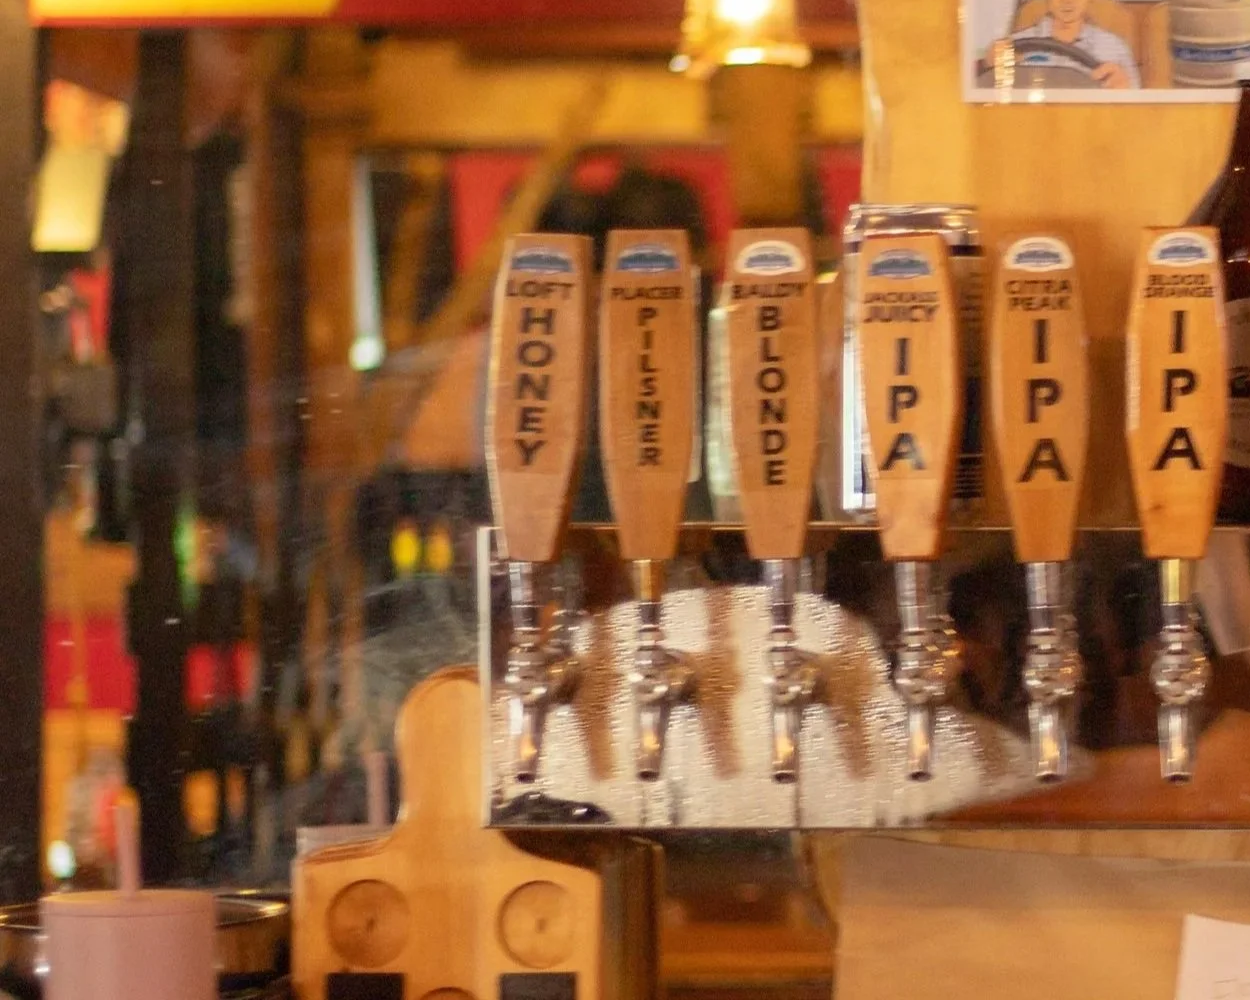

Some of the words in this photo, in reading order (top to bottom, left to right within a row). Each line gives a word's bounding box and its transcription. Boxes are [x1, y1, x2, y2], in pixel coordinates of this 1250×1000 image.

[506, 280, 575, 298] LOFT
[514, 307, 556, 467] HONEY
[635, 306, 663, 468] PILSNER
[757, 305, 787, 487] BLONDE
[879, 336, 928, 471] IPA
[1016, 318, 1073, 483] IPA
[1150, 309, 1206, 472] IPA
